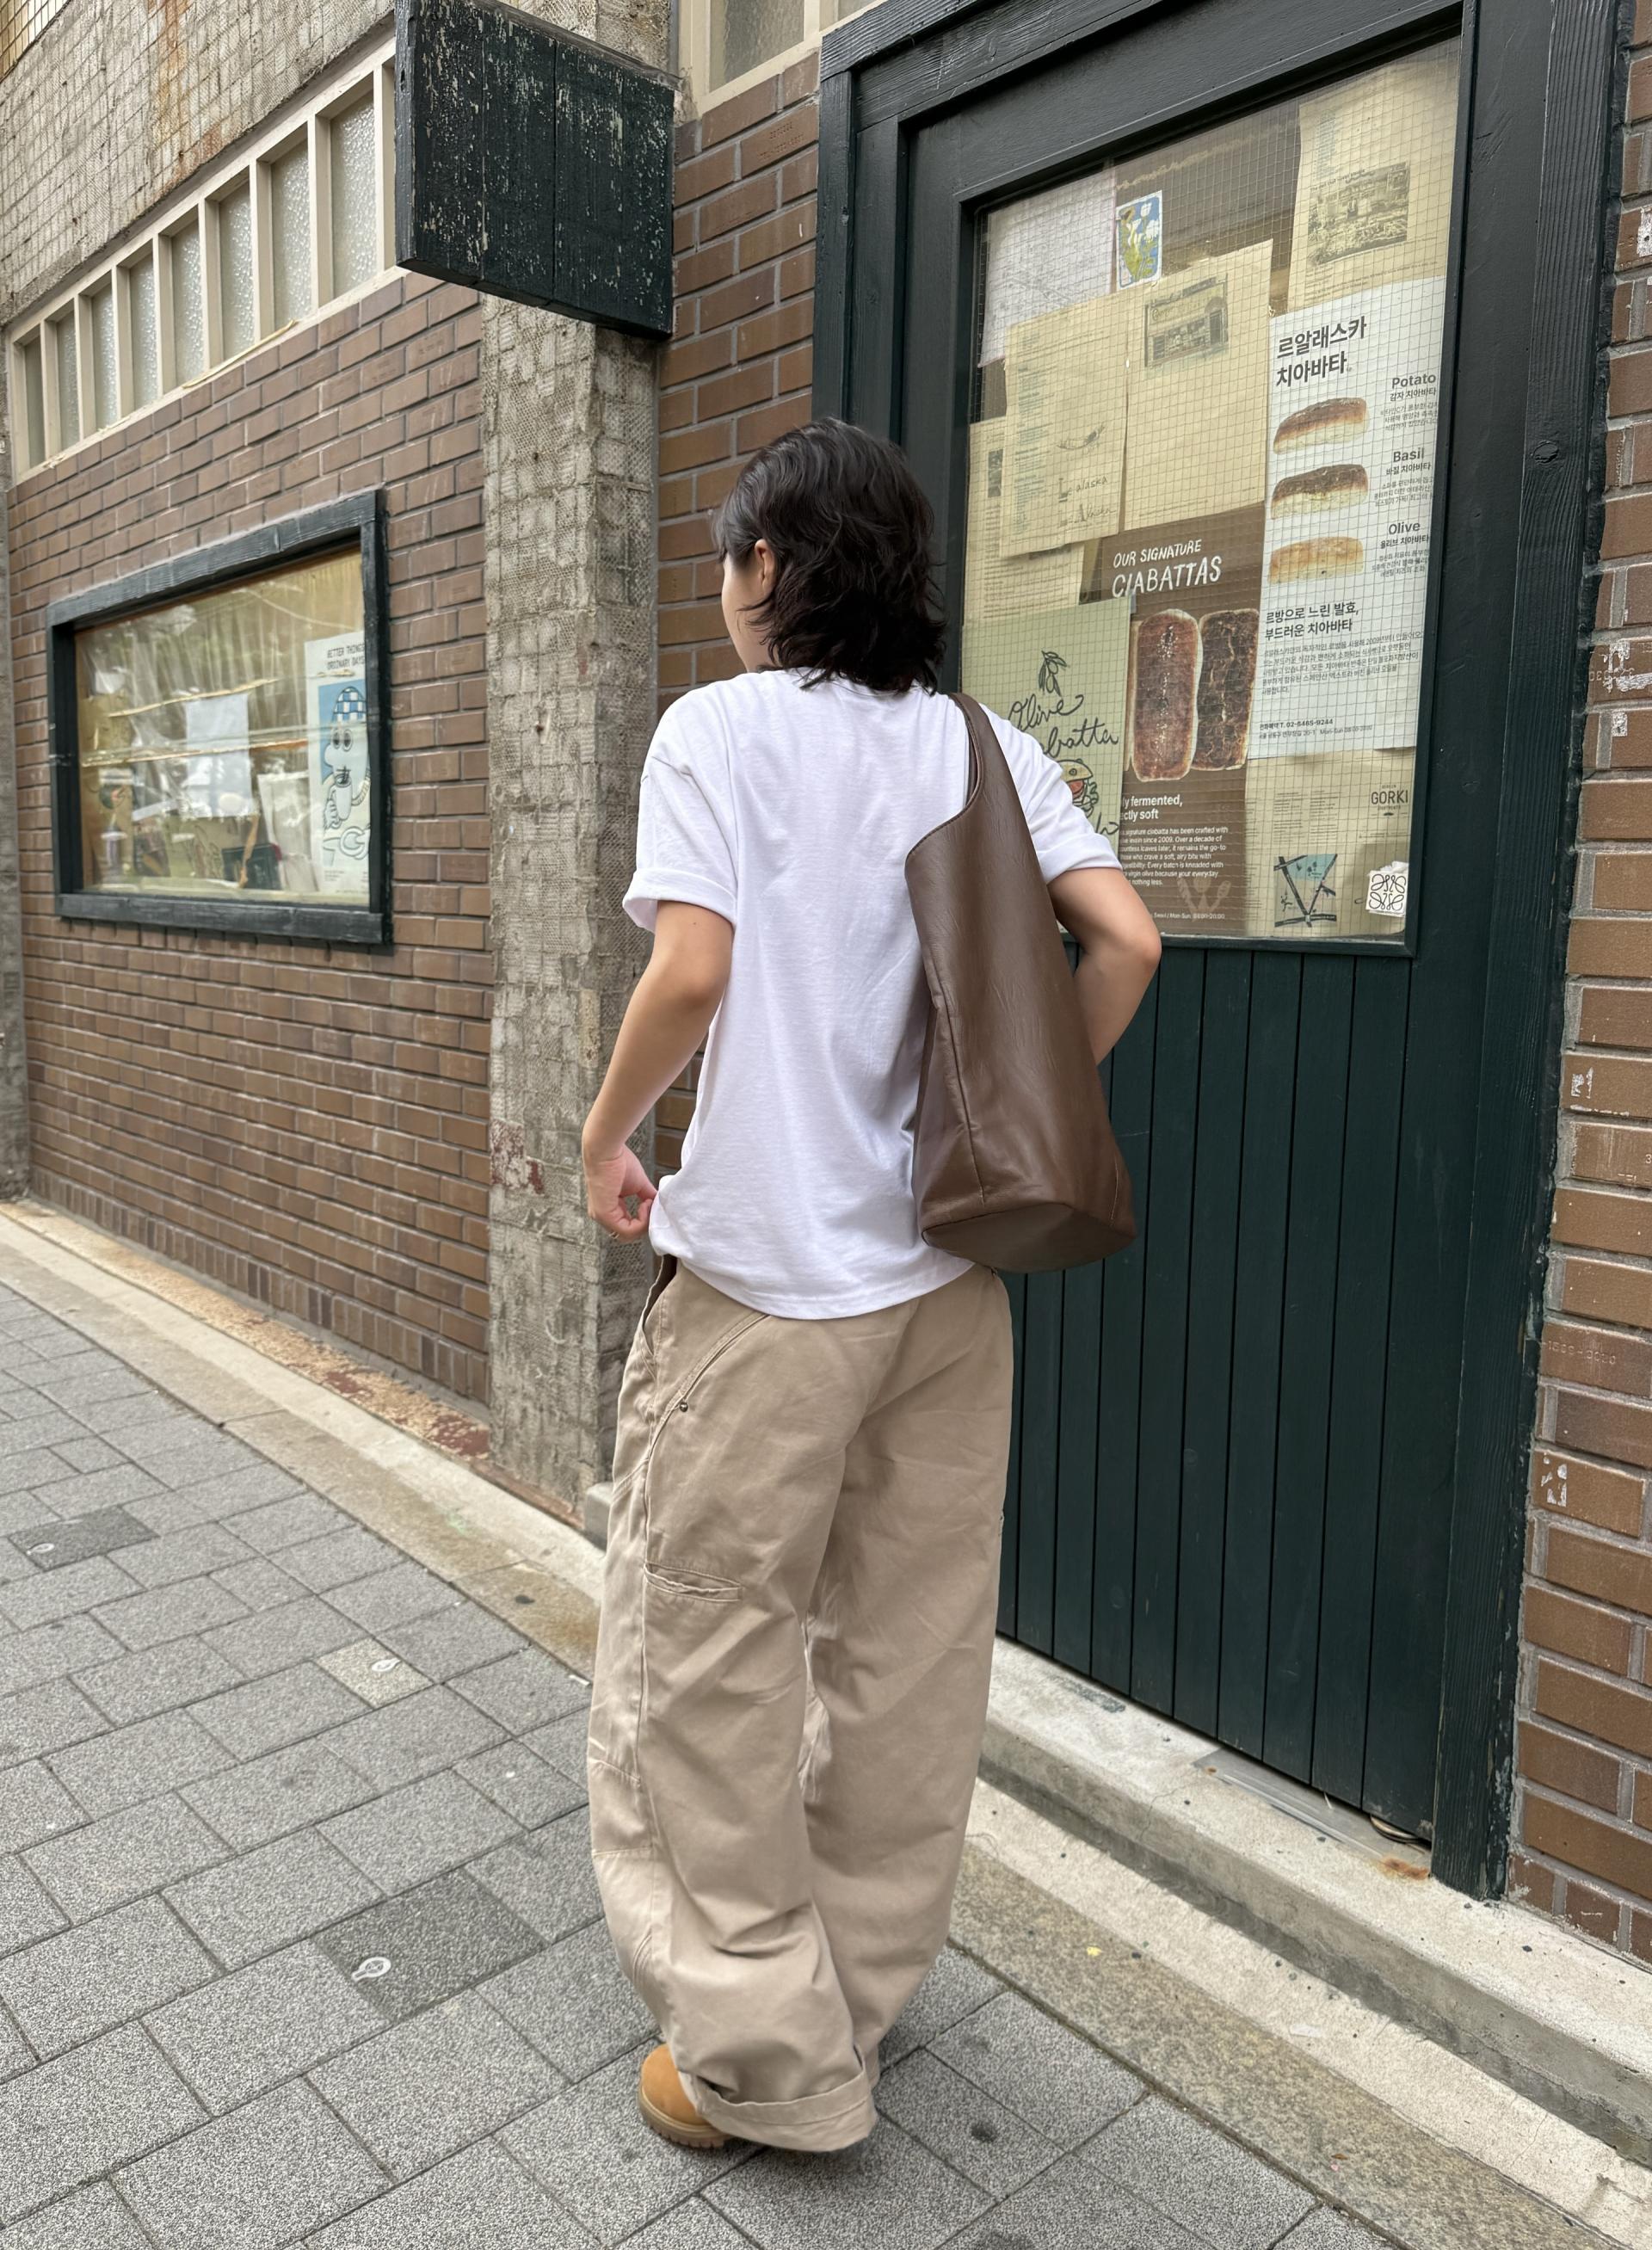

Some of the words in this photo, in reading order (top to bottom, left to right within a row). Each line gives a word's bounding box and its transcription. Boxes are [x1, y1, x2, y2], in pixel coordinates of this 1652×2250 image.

[1277, 315, 1367, 359] 르알래스카
[1276, 350, 1347, 387] 치아바타
[1391, 373, 1437, 390] Potato
[1390, 391, 1404, 402] 감자
[1406, 386, 1437, 399] 치아바타
[1393, 447, 1425, 463] Basil
[1386, 465, 1400, 476] 바질
[1401, 461, 1432, 473] 치아바타
[1388, 521, 1421, 535] Olive
[1380, 539, 1398, 550] 올리브
[1400, 534, 1430, 545] 치아바타
[1113, 551, 1137, 569] OUR
[1139, 539, 1202, 563] SIGNATURE
[1112, 555, 1223, 598] CIABATTAS
[1266, 607, 1306, 625] 르방으로
[1307, 603, 1331, 618] 느린
[1334, 601, 1359, 616] 발효,
[1265, 623, 1305, 641] 부드러운
[1307, 618, 1353, 635] 치아바타
[1008, 693, 1085, 732] Olive
[1131, 794, 1183, 808] fermented,
[1372, 790, 1409, 804] GORKI
[1139, 808, 1160, 820] soft
[1209, 844, 1227, 853] go-to
[1176, 853, 1187, 861] airy
[1147, 861, 1163, 870] Every
